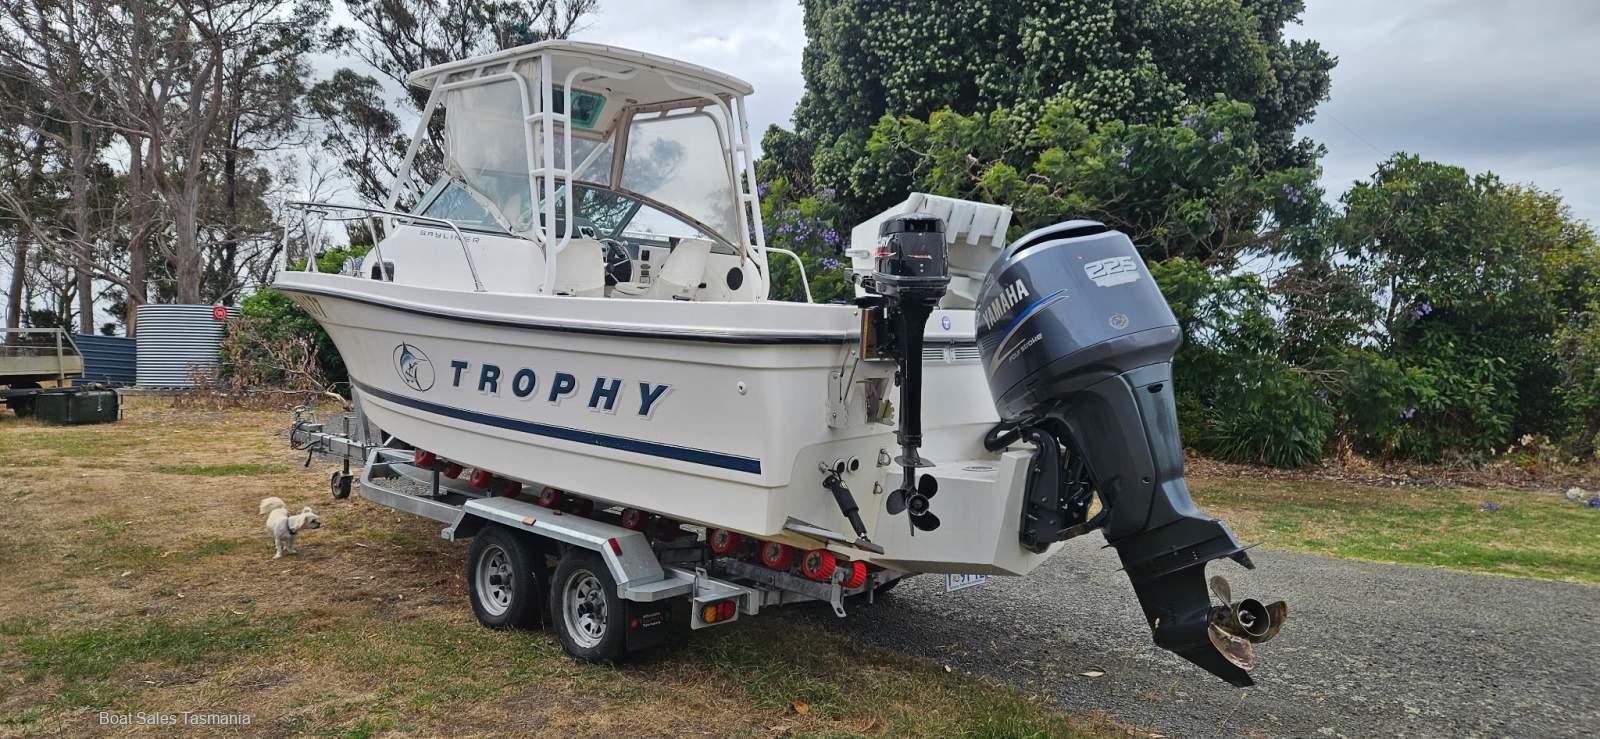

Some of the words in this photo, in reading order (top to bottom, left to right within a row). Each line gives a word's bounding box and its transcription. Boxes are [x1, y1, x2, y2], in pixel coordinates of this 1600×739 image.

[1084, 256, 1137, 281] 225
[982, 278, 1030, 331] YAMAHA
[450, 359, 672, 420] TROPHY
